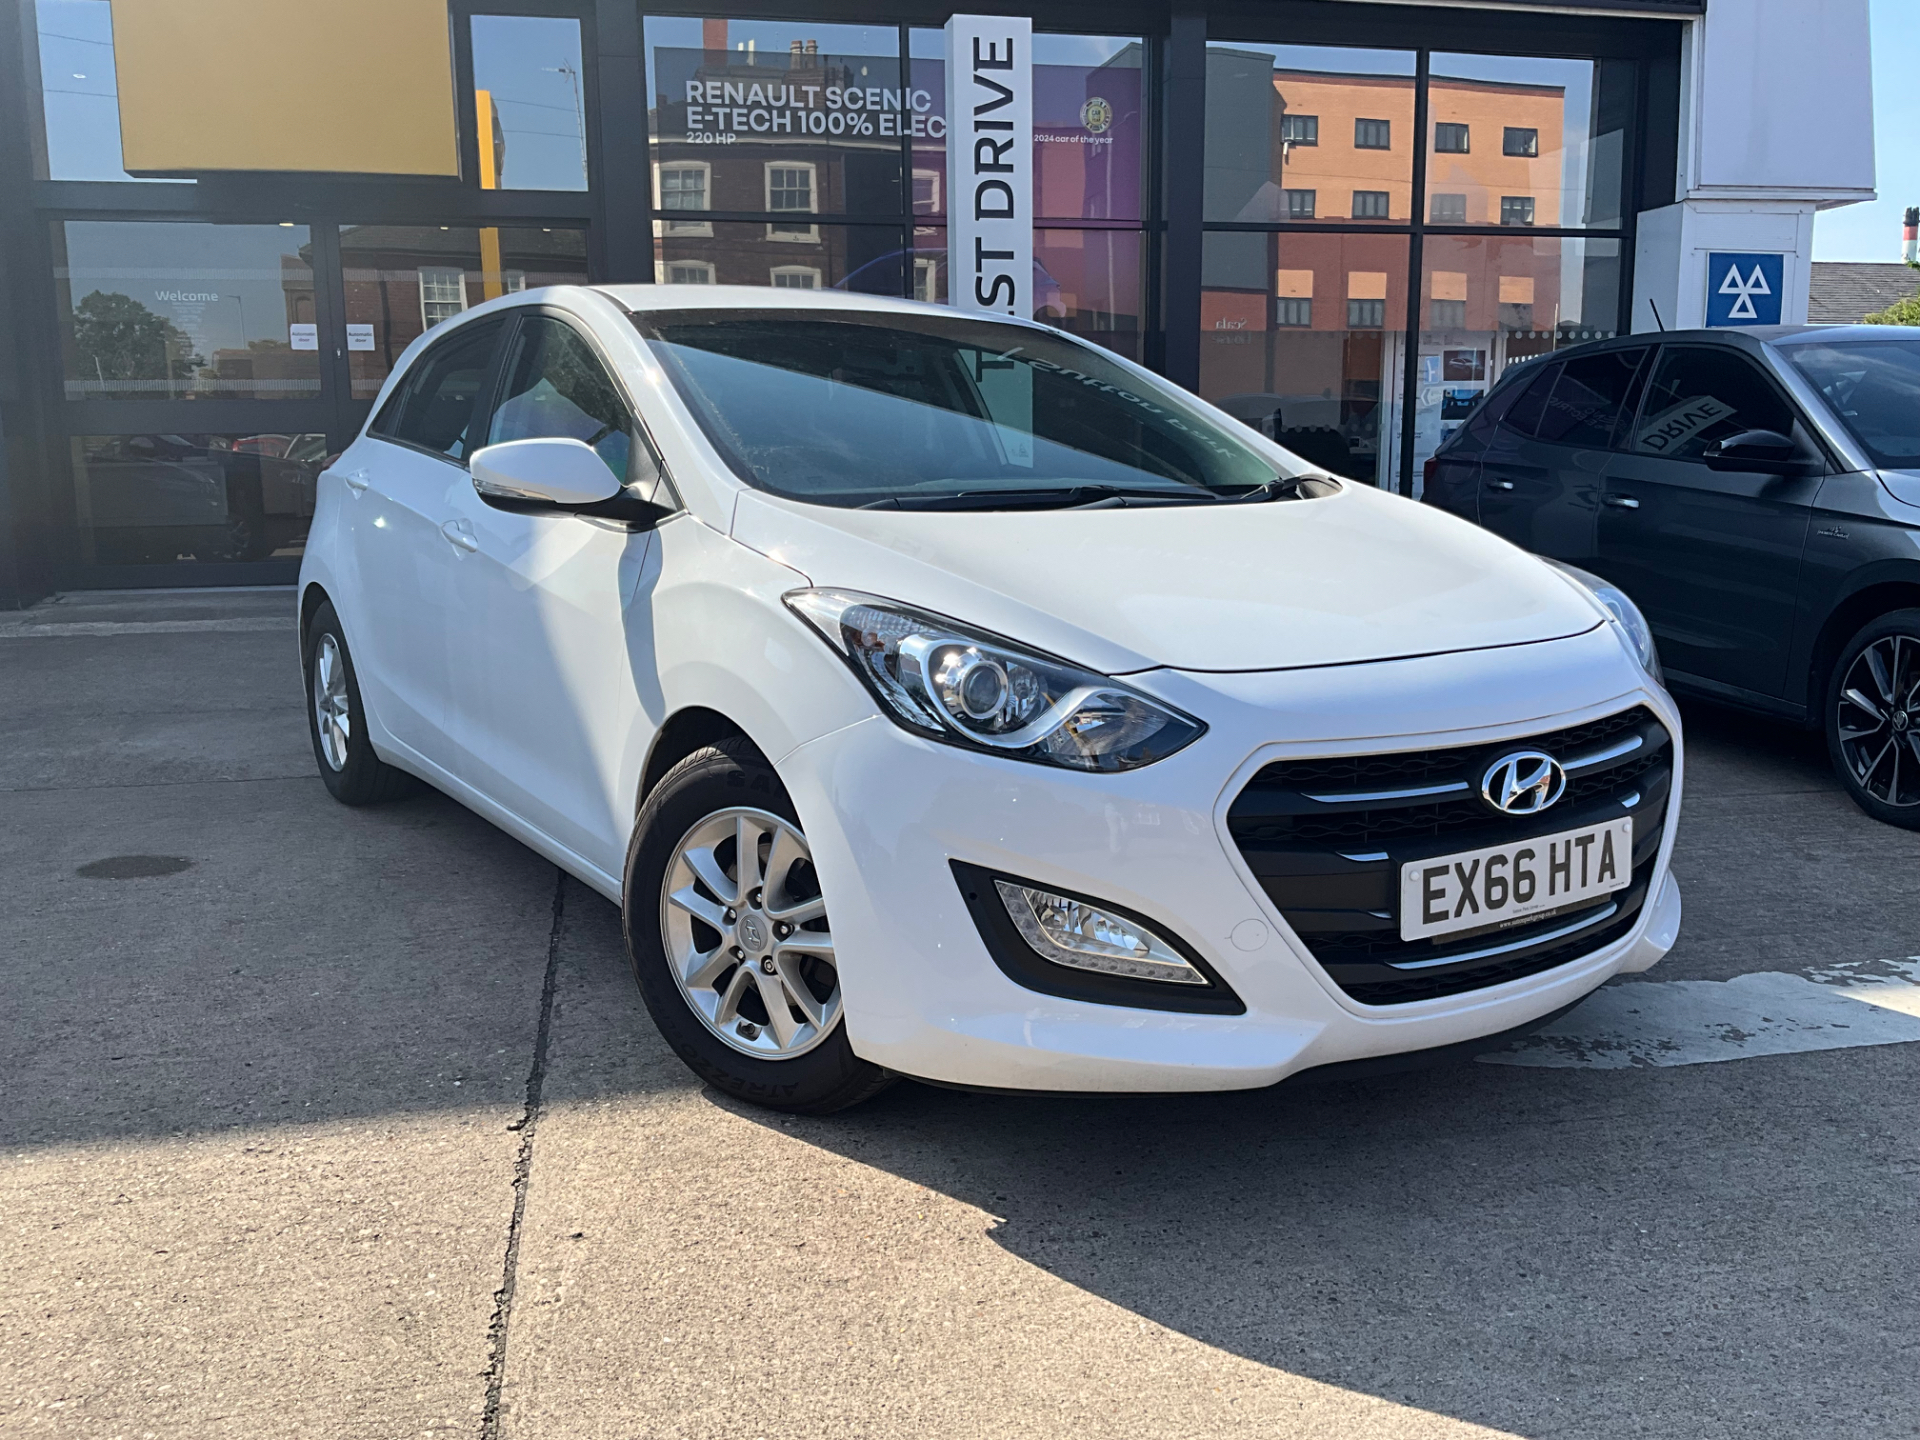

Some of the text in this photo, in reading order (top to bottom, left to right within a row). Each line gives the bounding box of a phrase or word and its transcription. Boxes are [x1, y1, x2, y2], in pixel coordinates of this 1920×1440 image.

[685, 80, 932, 113] RENAULT SCENIC
[687, 106, 791, 132] E-TECH
[797, 110, 874, 136] 100%
[973, 35, 1016, 221] DRIVE
[686, 131, 737, 145] 220 HP
[1033, 134, 1054, 142] 2024
[1070, 134, 1079, 143] of
[1080, 134, 1095, 143] the
[1094, 136, 1114, 146] year
[155, 290, 219, 302] Welcome
[1422, 829, 1616, 926] EX66 HTA
